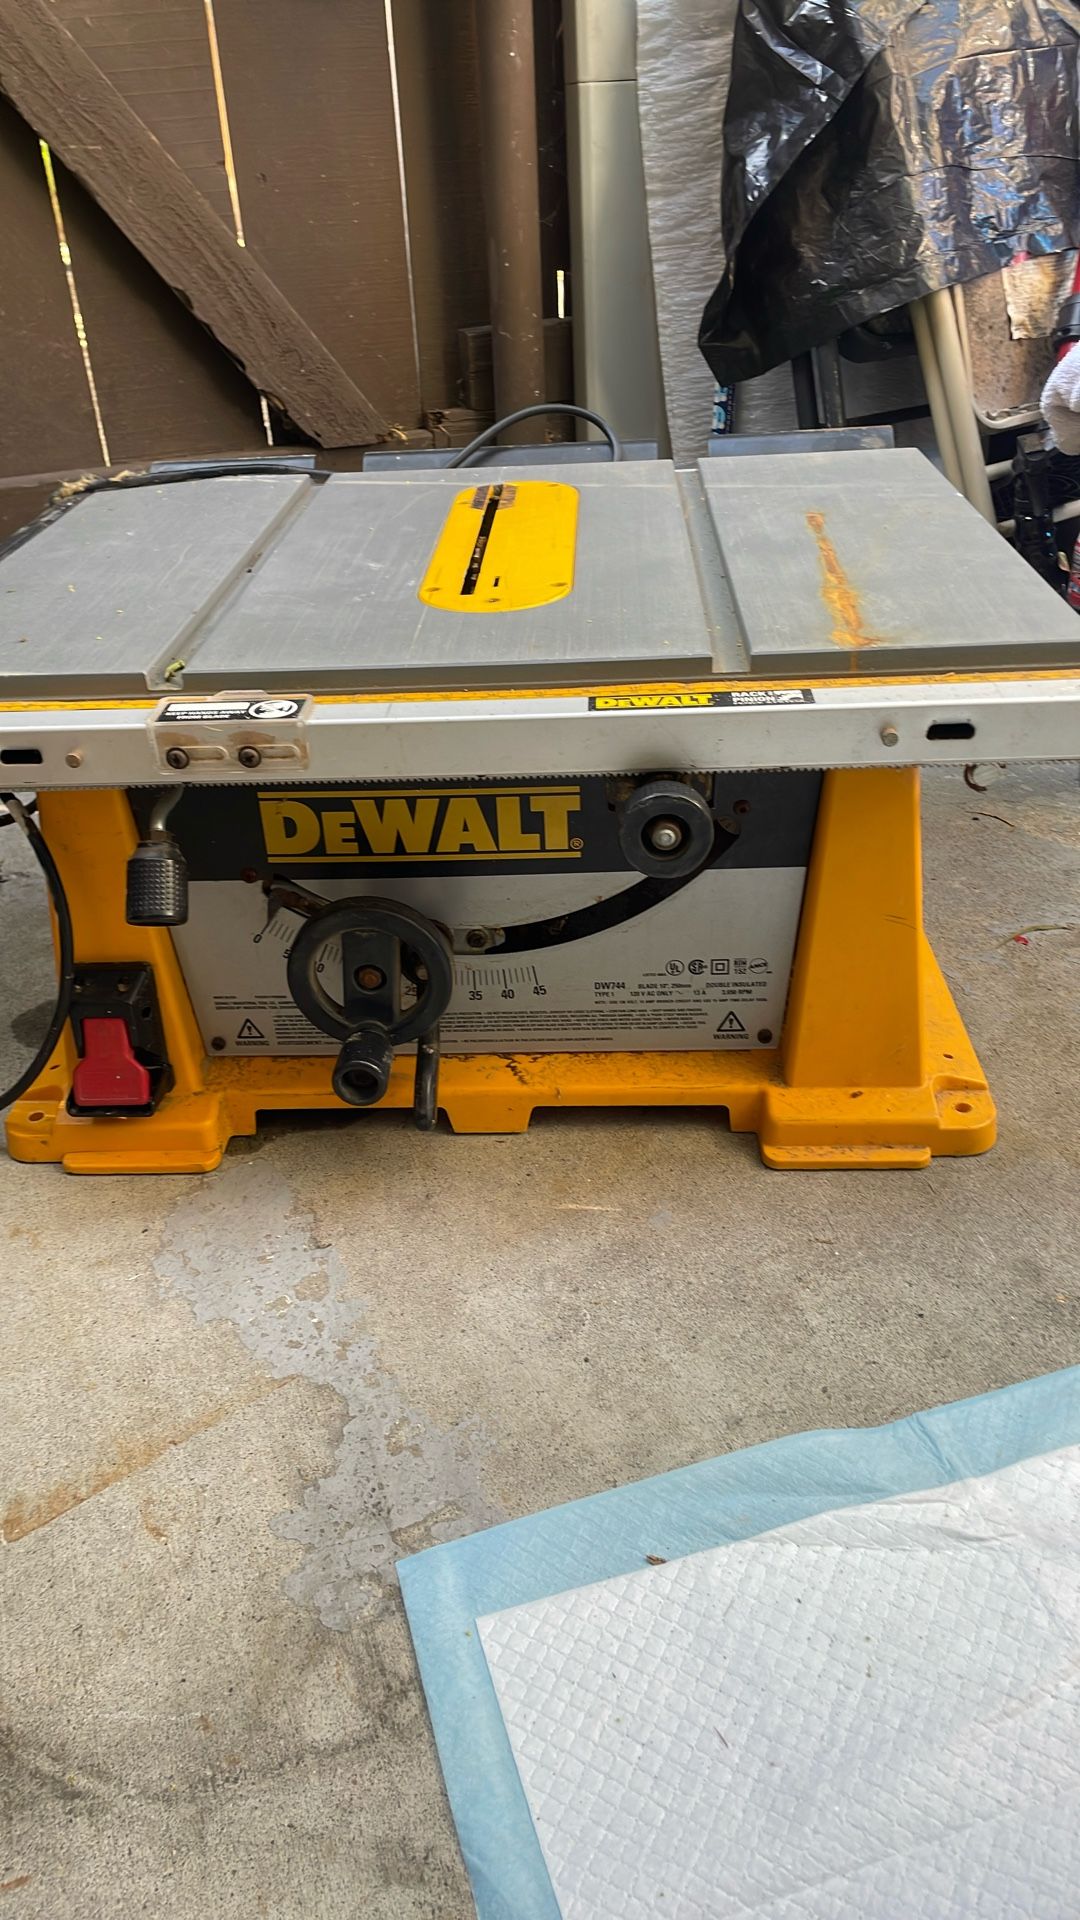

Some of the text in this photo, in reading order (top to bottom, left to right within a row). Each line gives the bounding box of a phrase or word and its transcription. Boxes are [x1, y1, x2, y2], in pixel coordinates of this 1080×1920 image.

[253, 934, 262, 943] 0
[532, 984, 547, 996] 45
[594, 982, 626, 990] DW744
[468, 990, 483, 1001] 35
[501, 988, 515, 1000] 40
